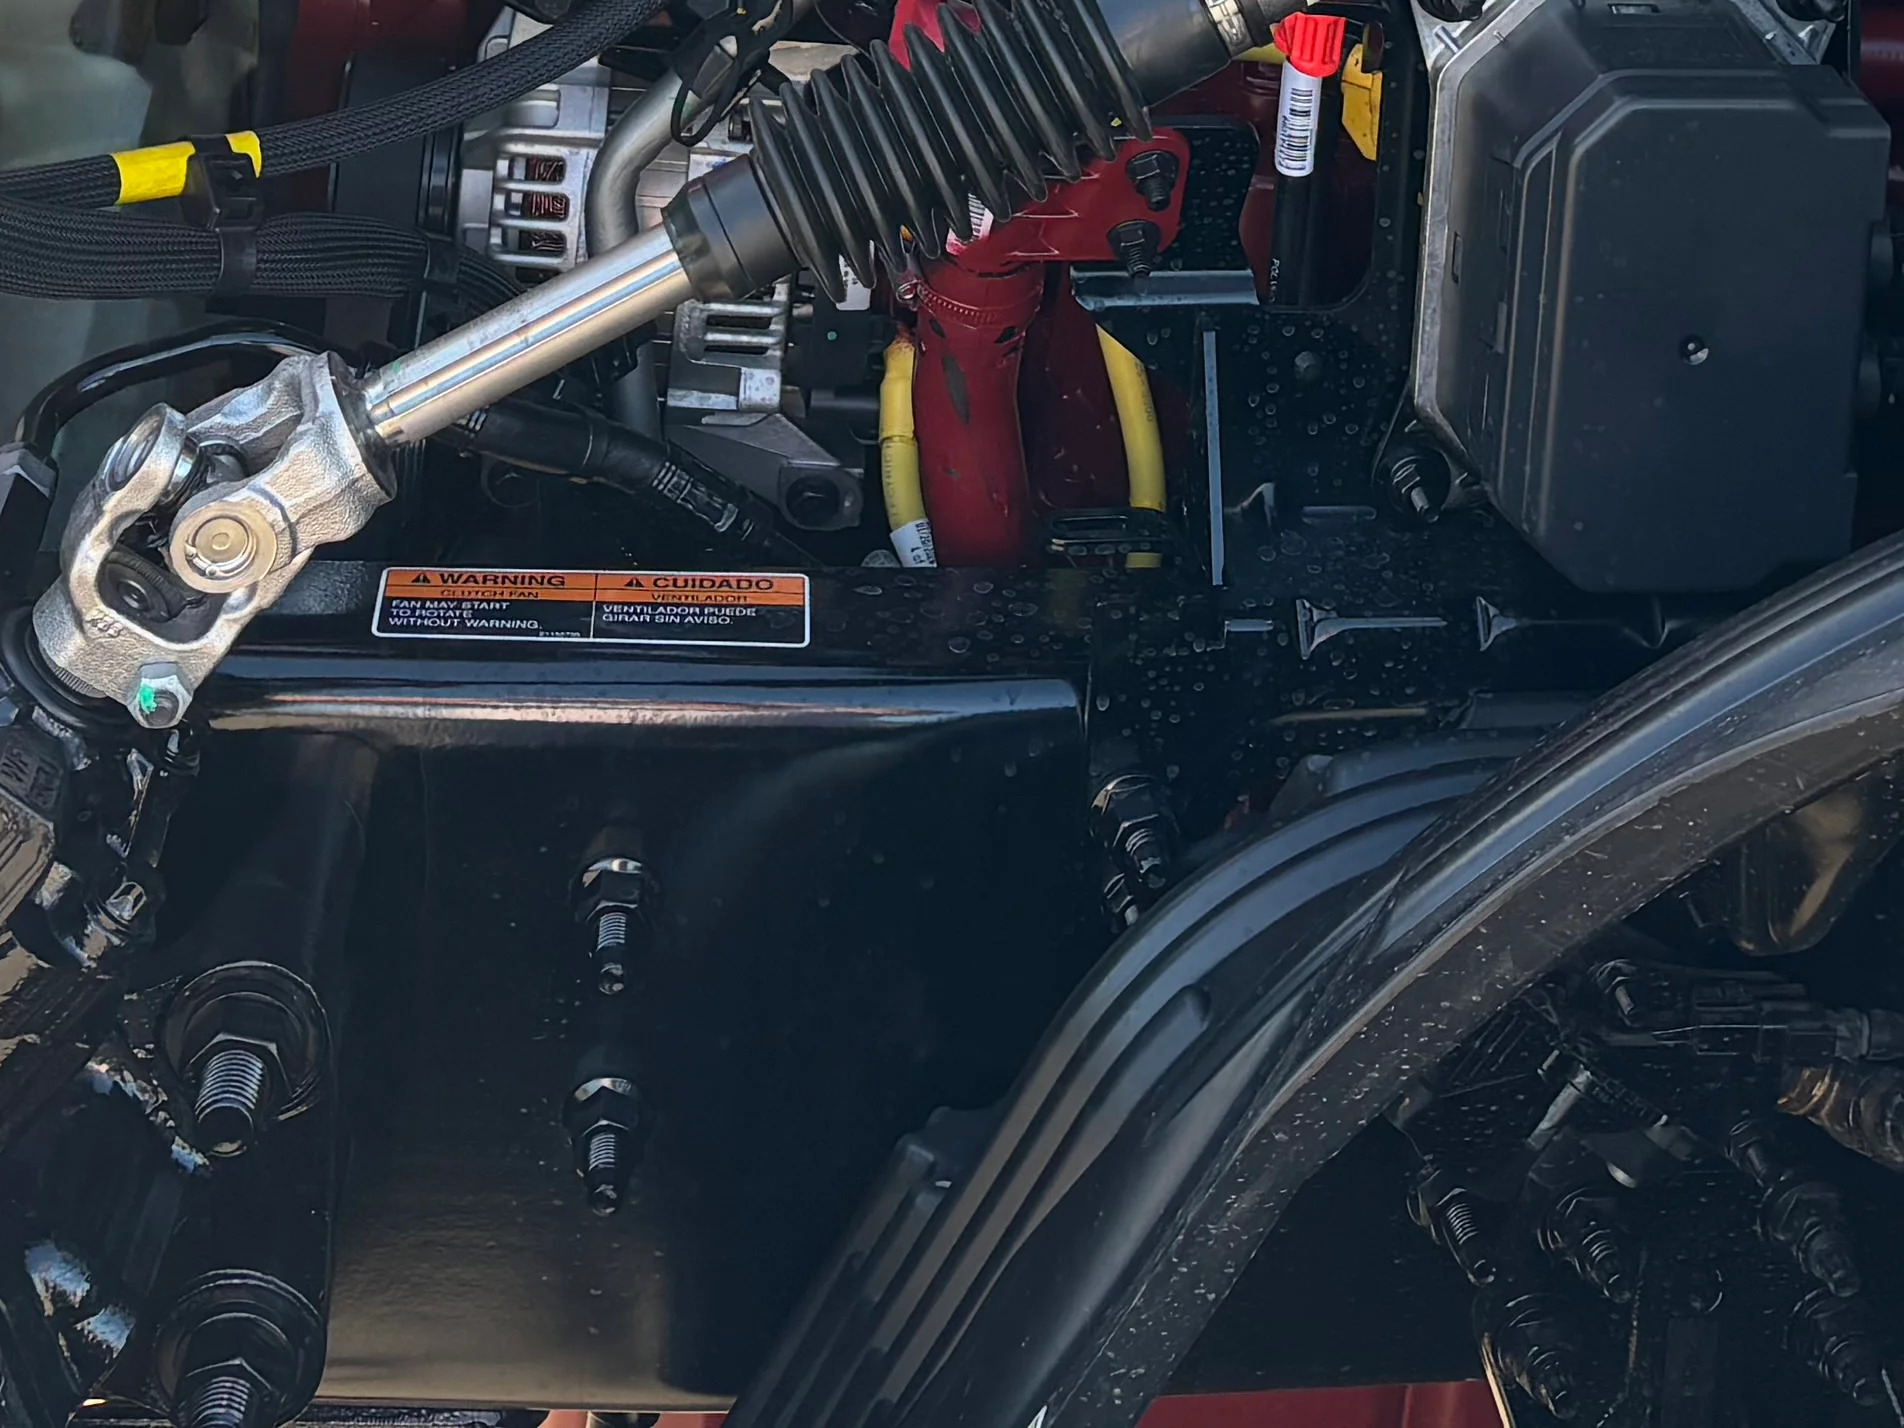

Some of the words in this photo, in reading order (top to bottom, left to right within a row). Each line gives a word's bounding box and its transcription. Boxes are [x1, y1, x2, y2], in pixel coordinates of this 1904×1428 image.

[439, 573, 566, 588] WARNING
[653, 577, 774, 591] CUIDADO
[391, 600, 421, 609] FAN
[426, 601, 458, 610] MAY
[462, 602, 510, 611] START
[602, 605, 704, 615] VENTILADOR
[708, 607, 757, 617] PUEDE
[391, 609, 411, 617] TO
[389, 618, 461, 627] WITHOUT
[602, 614, 651, 622] GIRAR
[656, 615, 679, 624] SIN
